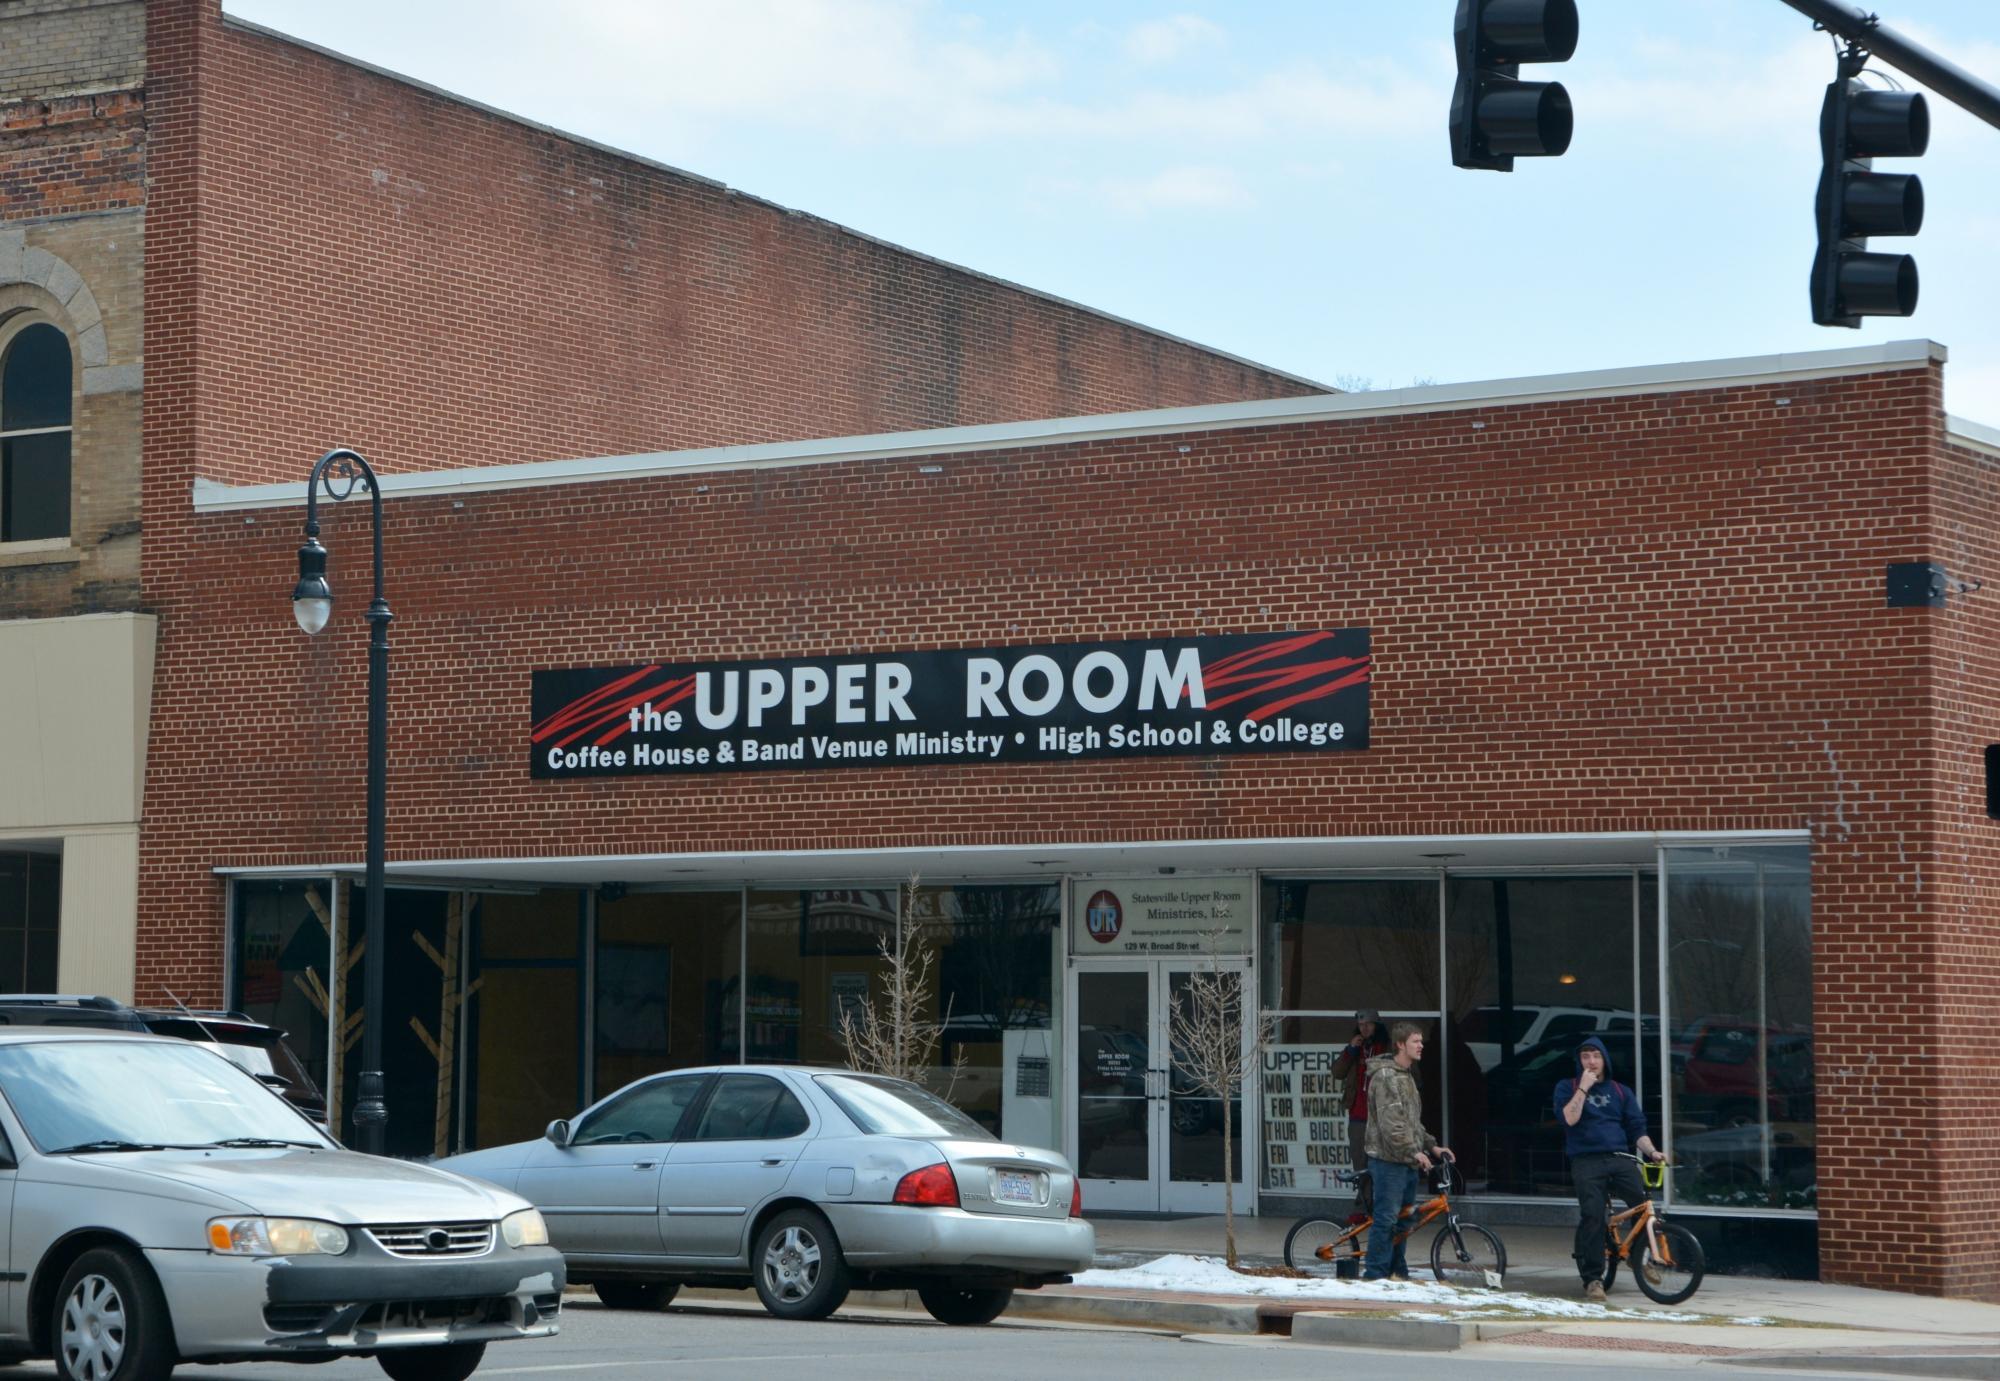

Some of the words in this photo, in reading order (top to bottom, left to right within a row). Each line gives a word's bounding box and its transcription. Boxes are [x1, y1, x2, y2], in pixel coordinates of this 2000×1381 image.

[629, 702, 682, 733] the
[695, 662, 917, 730] UPPER
[967, 648, 1207, 718] ROOM
[548, 744, 627, 769] Coffee
[633, 742, 710, 767] House
[716, 741, 736, 763] &
[741, 738, 804, 763] Band
[811, 736, 888, 759] Venue
[895, 730, 1004, 757] Ministry
[1039, 726, 1101, 754] High
[1108, 722, 1202, 748] School
[1210, 720, 1231, 743] &
[1239, 718, 1344, 746] College
[1131, 892, 1179, 904] Statesville
[1181, 892, 1211, 905] Upper
[1213, 891, 1241, 902] Room
[1147, 908, 1208, 920] Ministries,
[1124, 942, 1138, 951] 129
[1150, 942, 1174, 951] Broad
[1265, 1073, 1291, 1094] MON
[1271, 1098, 1294, 1118] FOR
[1301, 1098, 1346, 1118] WOMEN
[1264, 1121, 1297, 1141] THUR
[1309, 1121, 1345, 1141] BIBLE
[1270, 1145, 1289, 1165] FRI
[1306, 1145, 1351, 1165] CLOSED
[1270, 1169, 1296, 1188] SAT
